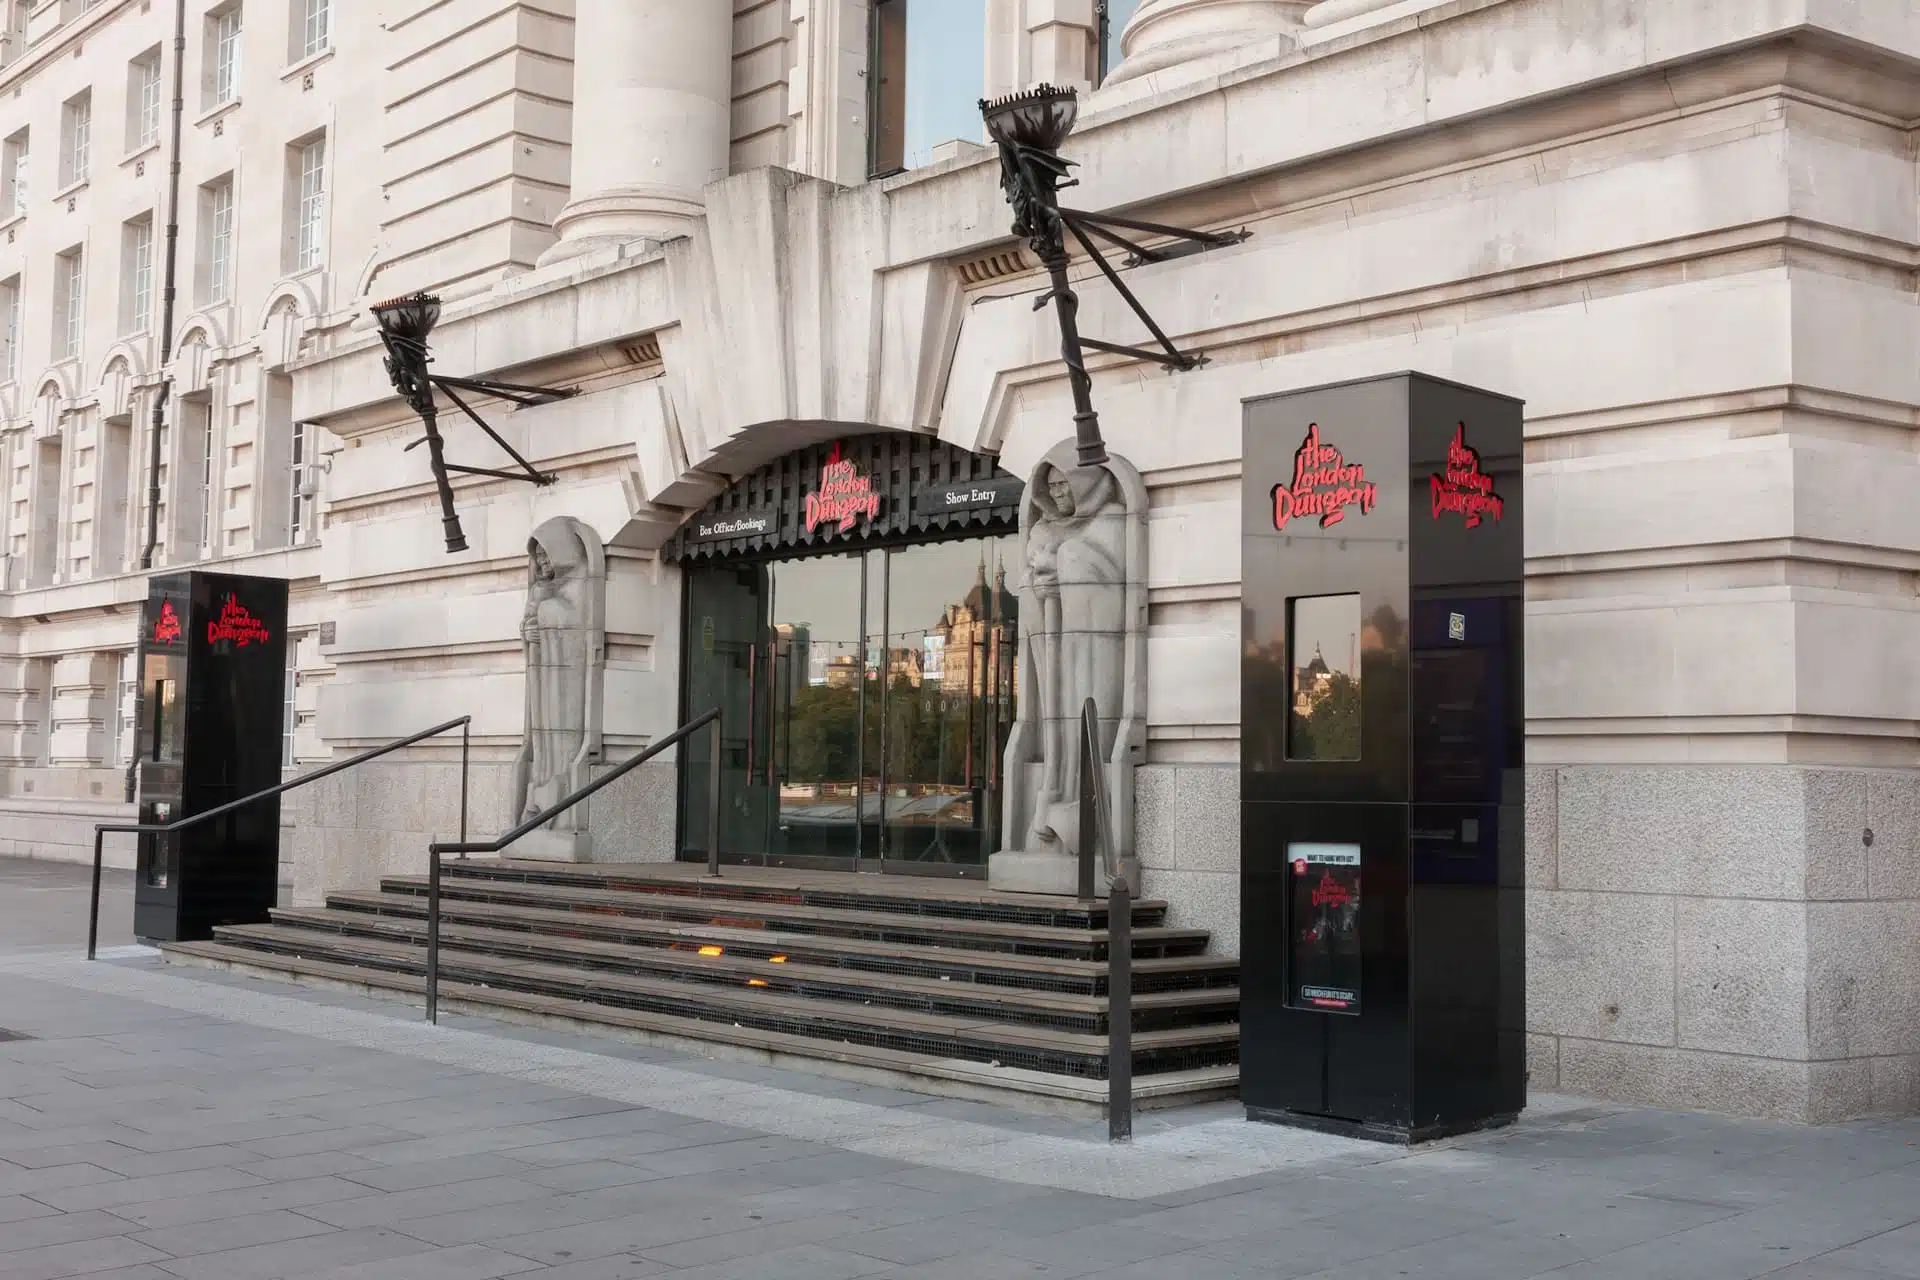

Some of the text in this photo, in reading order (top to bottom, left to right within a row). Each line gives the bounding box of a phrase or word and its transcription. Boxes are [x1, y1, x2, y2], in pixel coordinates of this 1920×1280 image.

[1301, 423, 1338, 469] the
[819, 465, 870, 502] London
[1292, 451, 1364, 497] London
[1443, 444, 1493, 496] London
[805, 493, 879, 533] Dungeon
[946, 489, 996, 505] Show Entry
[1273, 482, 1377, 529] Dungeon
[1430, 475, 1504, 528] Dungeon
[699, 518, 766, 537] Box Office/Bookings
[208, 621, 269, 648] Dungeon
[220, 607, 261, 630] London
